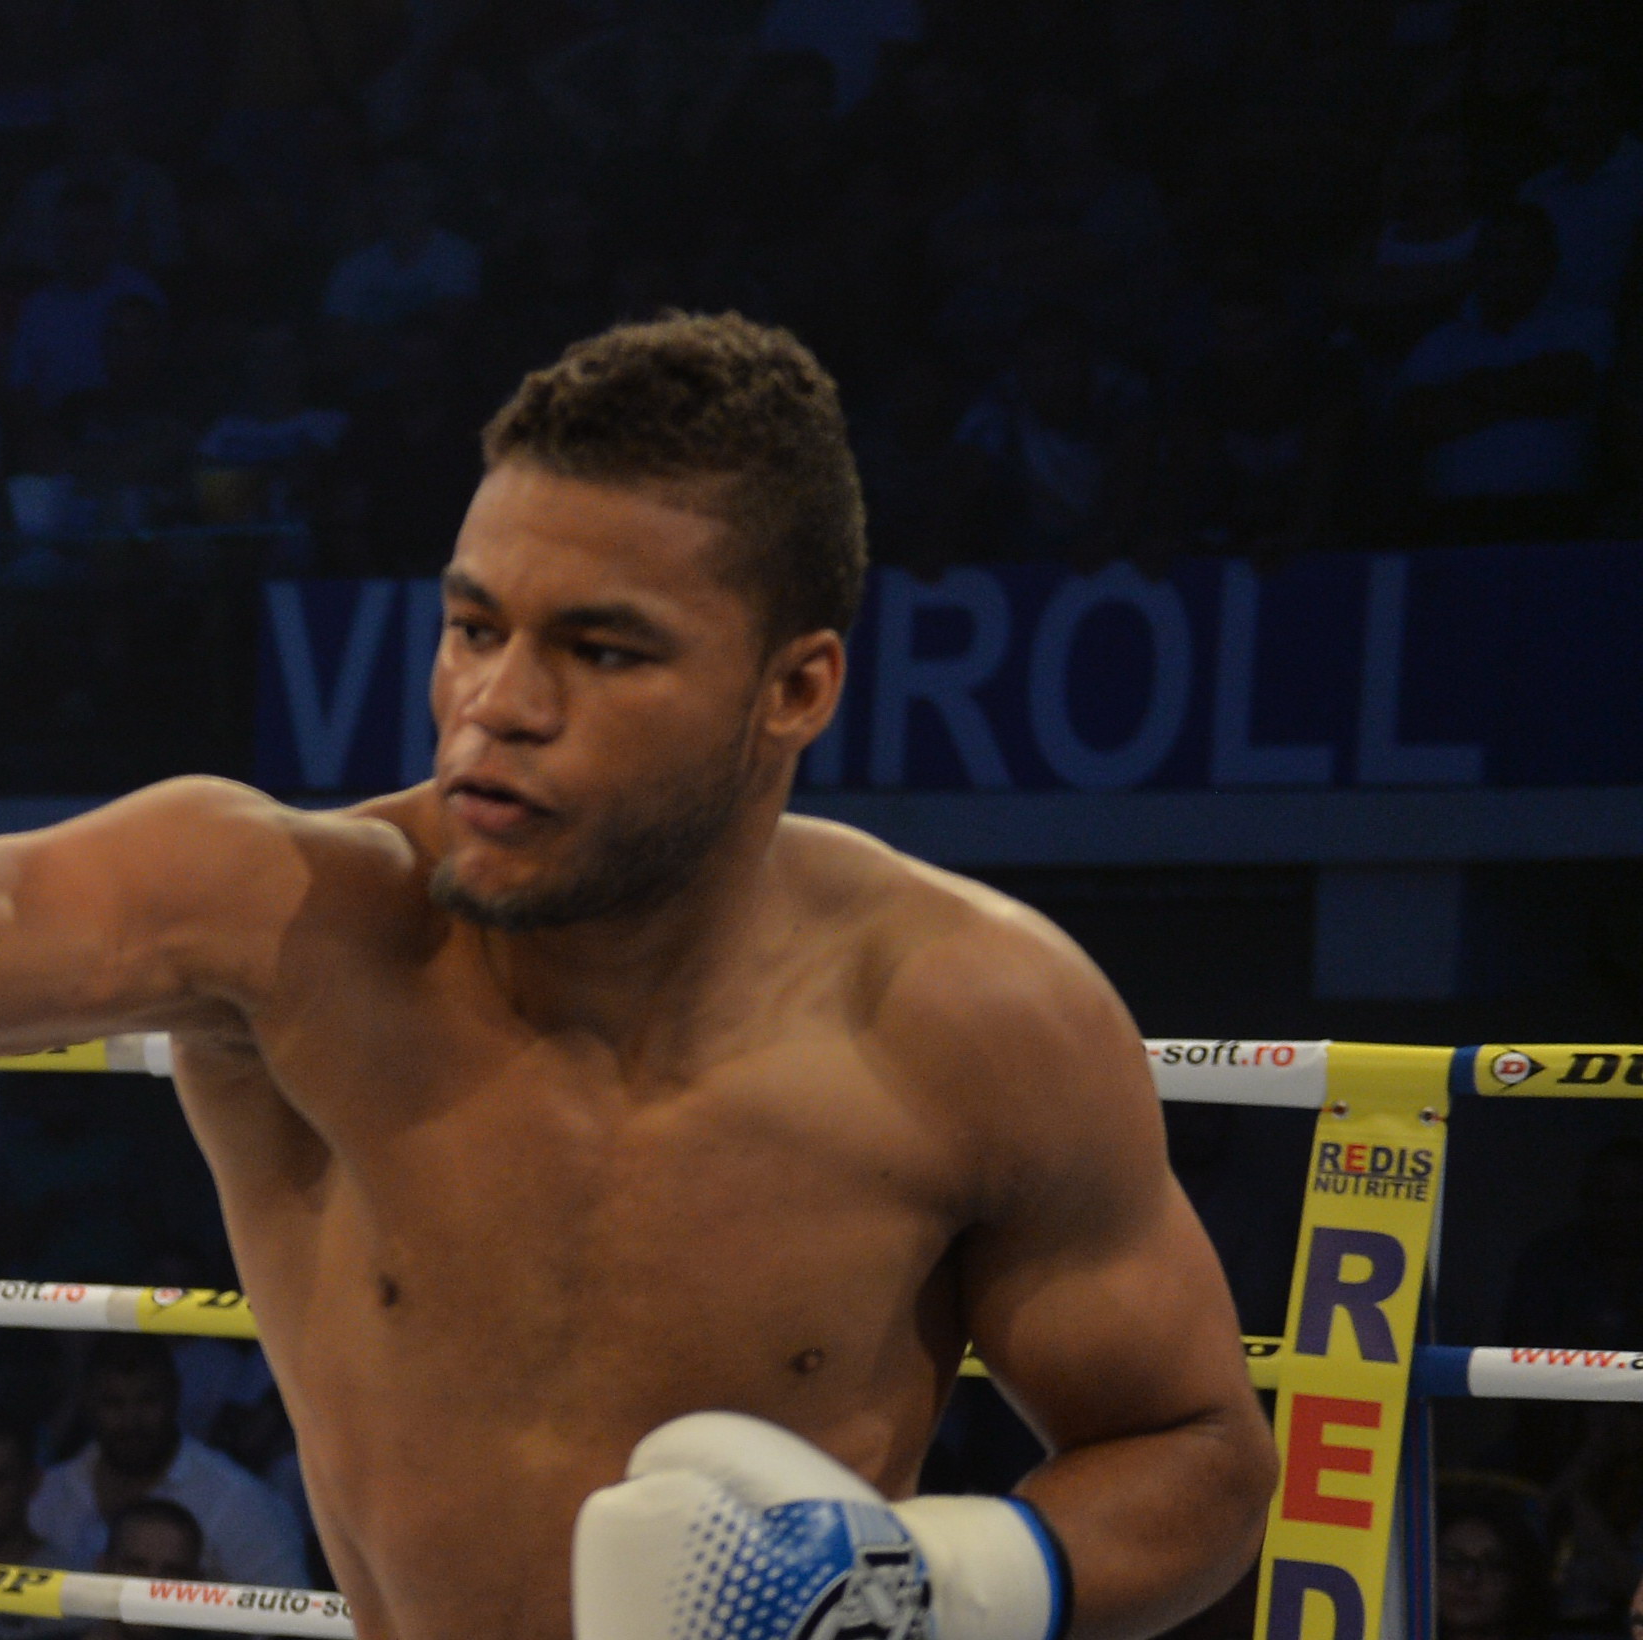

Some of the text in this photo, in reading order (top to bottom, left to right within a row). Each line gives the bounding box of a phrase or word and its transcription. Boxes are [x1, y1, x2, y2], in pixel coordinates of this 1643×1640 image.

[1147, 1040, 1296, 1068] -soft.ro
[1318, 1143, 1433, 1180] REDIS
[1313, 1173, 1430, 1202] NUTRITIE
[149, 1582, 352, 1619] www.auto-s
